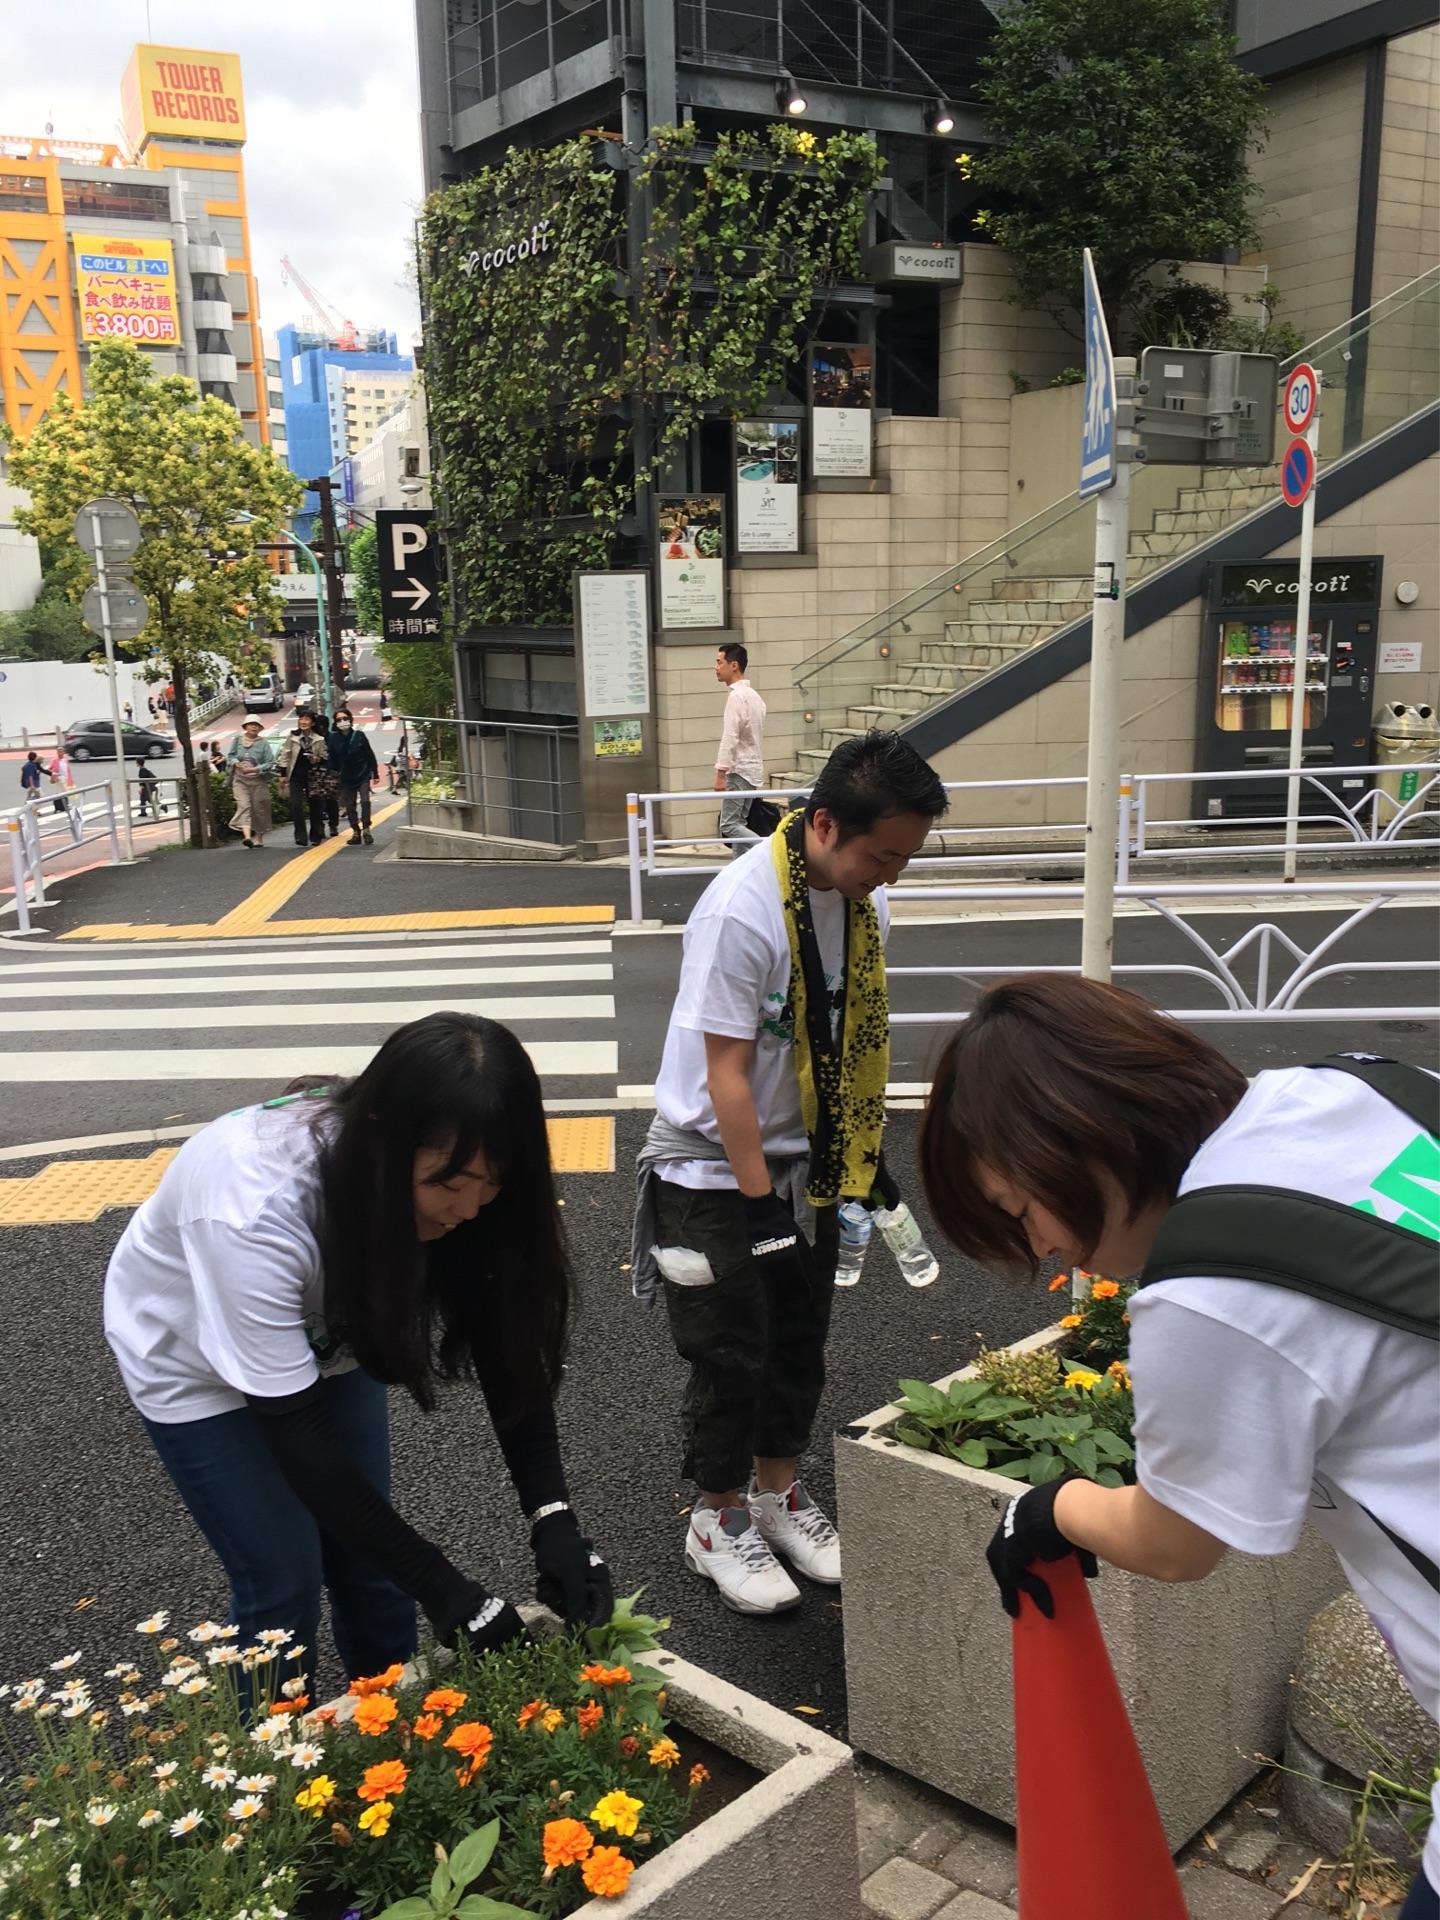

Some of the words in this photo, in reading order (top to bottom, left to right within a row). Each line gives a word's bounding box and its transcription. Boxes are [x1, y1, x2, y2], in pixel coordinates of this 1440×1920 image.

[156, 61, 224, 93] TOWER
[152, 90, 240, 124] RECORDS
[482, 219, 550, 271] cocoti
[914, 256, 956, 269] cocoti
[87, 274, 166, 292] バーベキュー
[84, 291, 172, 311] 食べ飲み放題
[1291, 383, 1310, 416] 30
[391, 523, 428, 570] P
[388, 617, 441, 635] 時間貸
